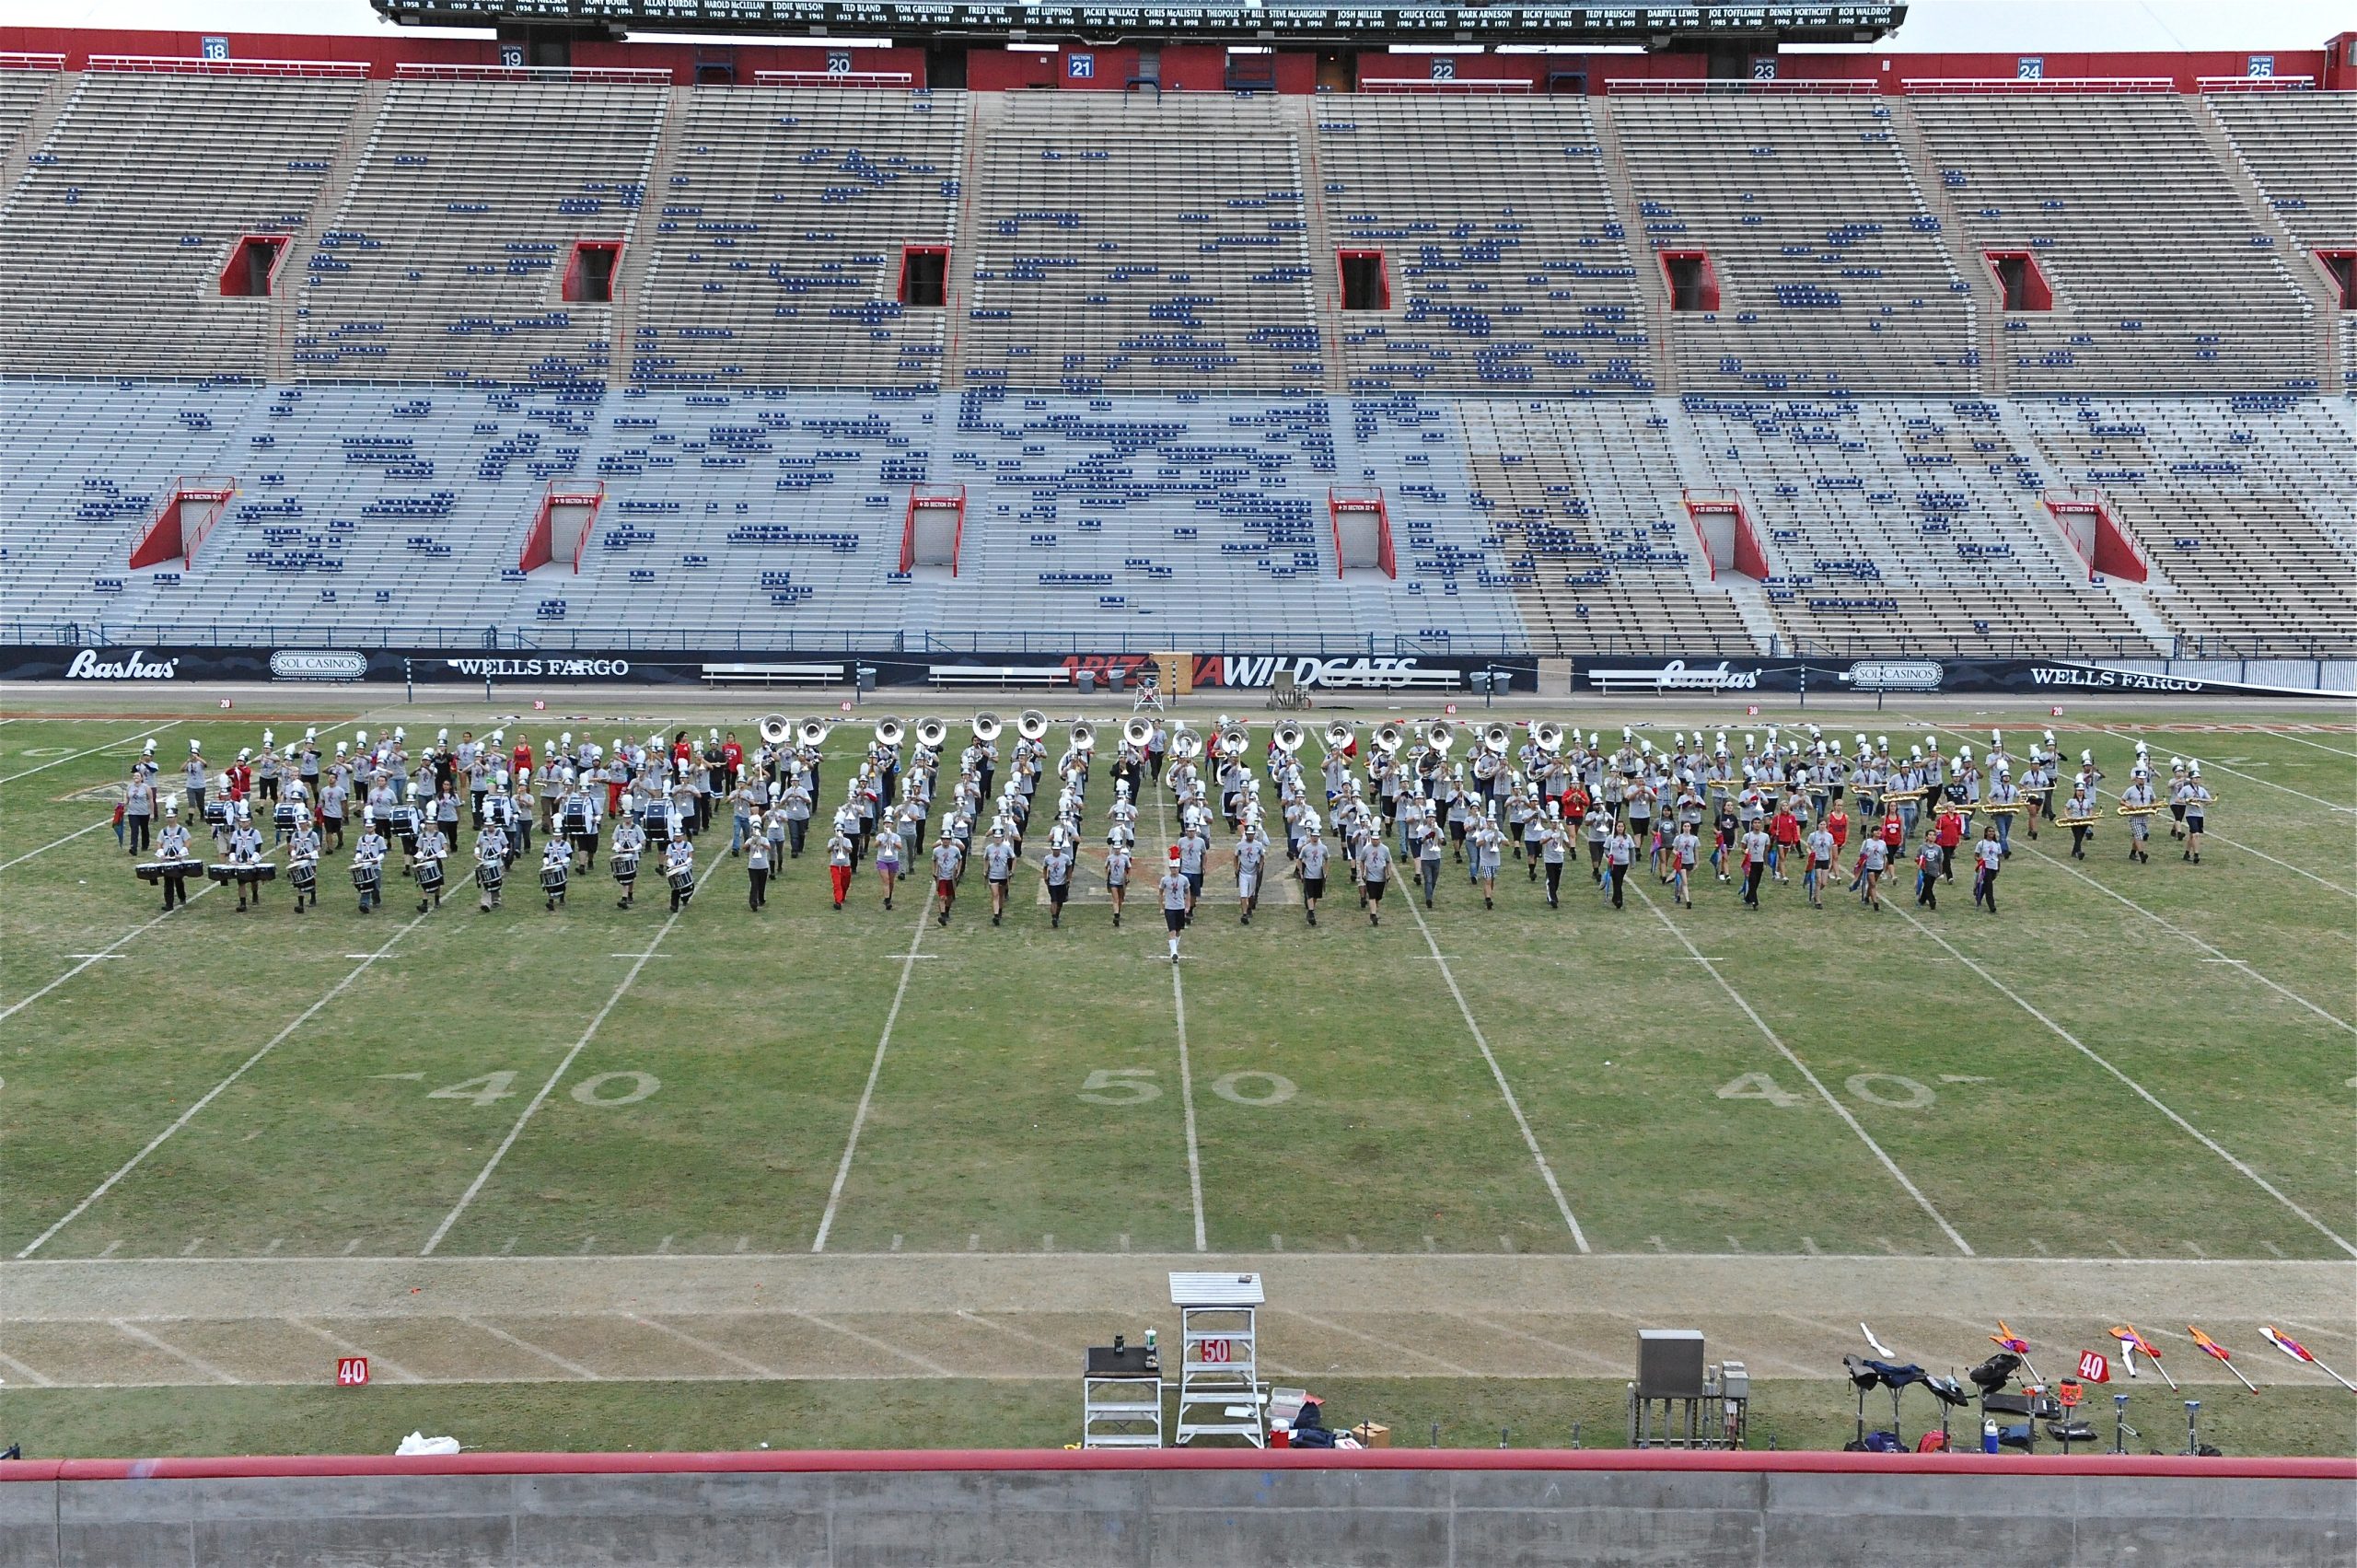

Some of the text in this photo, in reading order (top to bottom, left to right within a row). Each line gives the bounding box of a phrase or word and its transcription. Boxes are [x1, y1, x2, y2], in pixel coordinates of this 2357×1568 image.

[704, 0, 729, 8] HAROLD
[772, 2, 794, 10] EDDIE
[895, 5, 953, 13] TOM GREENFIELD
[987, 6, 1004, 15] ENKE
[1041, 7, 1072, 16] LUPPINO
[1084, 8, 1139, 17] JACKIE WALLACE
[1207, 9, 1238, 17] THEOPOLIS
[1338, 11, 1355, 19] JOSH
[1709, 10, 1722, 18] JOE
[1770, 7, 1792, 16] DENNIS
[206, 44, 226, 59] 18
[503, 52, 521, 66] 19
[829, 59, 850, 72] 20
[1073, 62, 1090, 75] 21
[1434, 65, 1453, 79] 22
[1755, 65, 1774, 79] 23
[2020, 65, 2040, 78] 24
[2250, 64, 2270, 77] 25
[65, 649, 179, 679] Bashas'
[280, 658, 357, 668] SOL CASINOS
[457, 659, 629, 676] WELLS FARGO
[1061, 656, 1223, 685] ARIZA
[1859, 668, 1933, 679] SOL CASINOS
[2031, 668, 2115, 685] WELLS
[1144, 688, 1153, 696] 50
[535, 701, 543, 709] 30
[842, 703, 851, 711] 40
[1447, 705, 1456, 714] 40
[1749, 706, 1758, 714] 30
[427, 1070, 661, 1106] 40
[1075, 1069, 1298, 1105] 50
[1716, 1072, 1935, 1109] 40
[1204, 1340, 1228, 1362] 50
[340, 1359, 366, 1383] 40
[2081, 1353, 2103, 1381] 40
